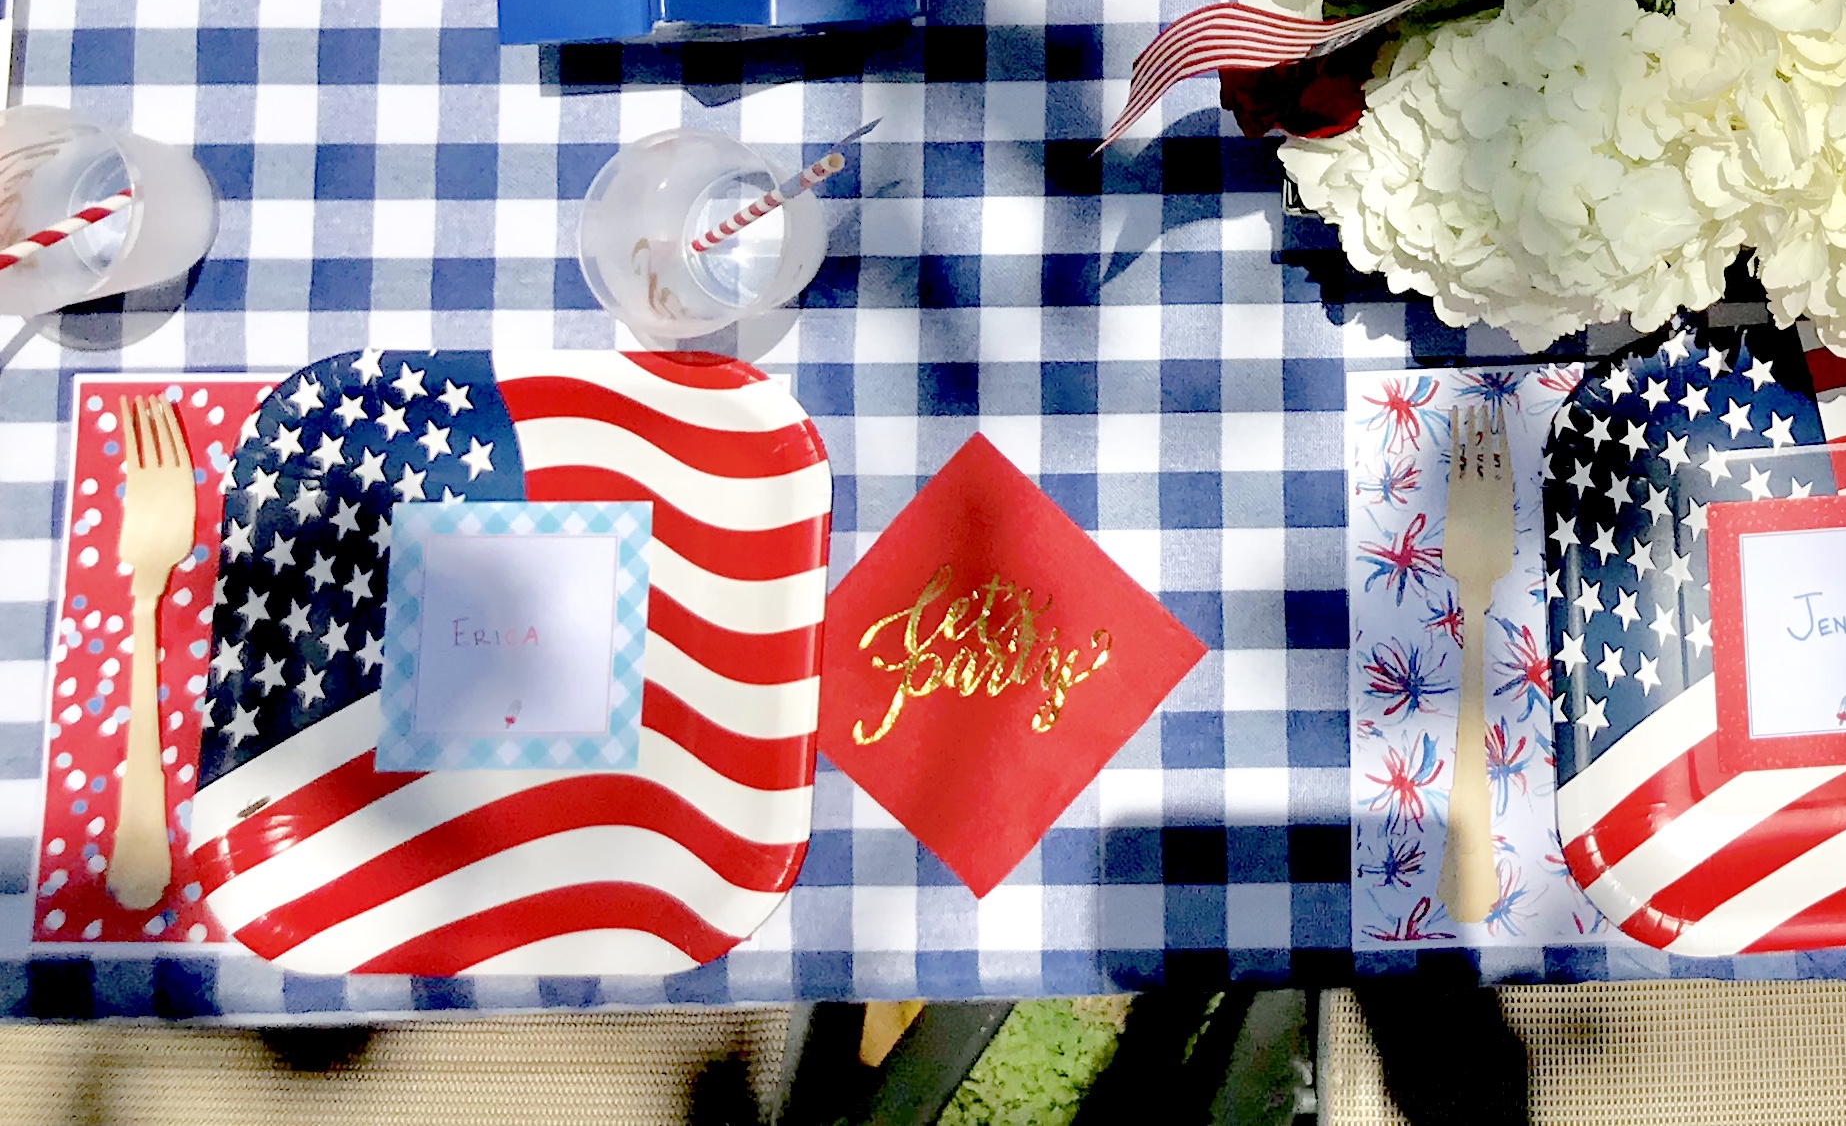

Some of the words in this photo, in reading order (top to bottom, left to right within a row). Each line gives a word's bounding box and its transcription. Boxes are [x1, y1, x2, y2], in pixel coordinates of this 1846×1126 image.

[451, 616, 540, 648] ERICA
[859, 563, 1053, 655] let's
[852, 626, 1112, 746] party
